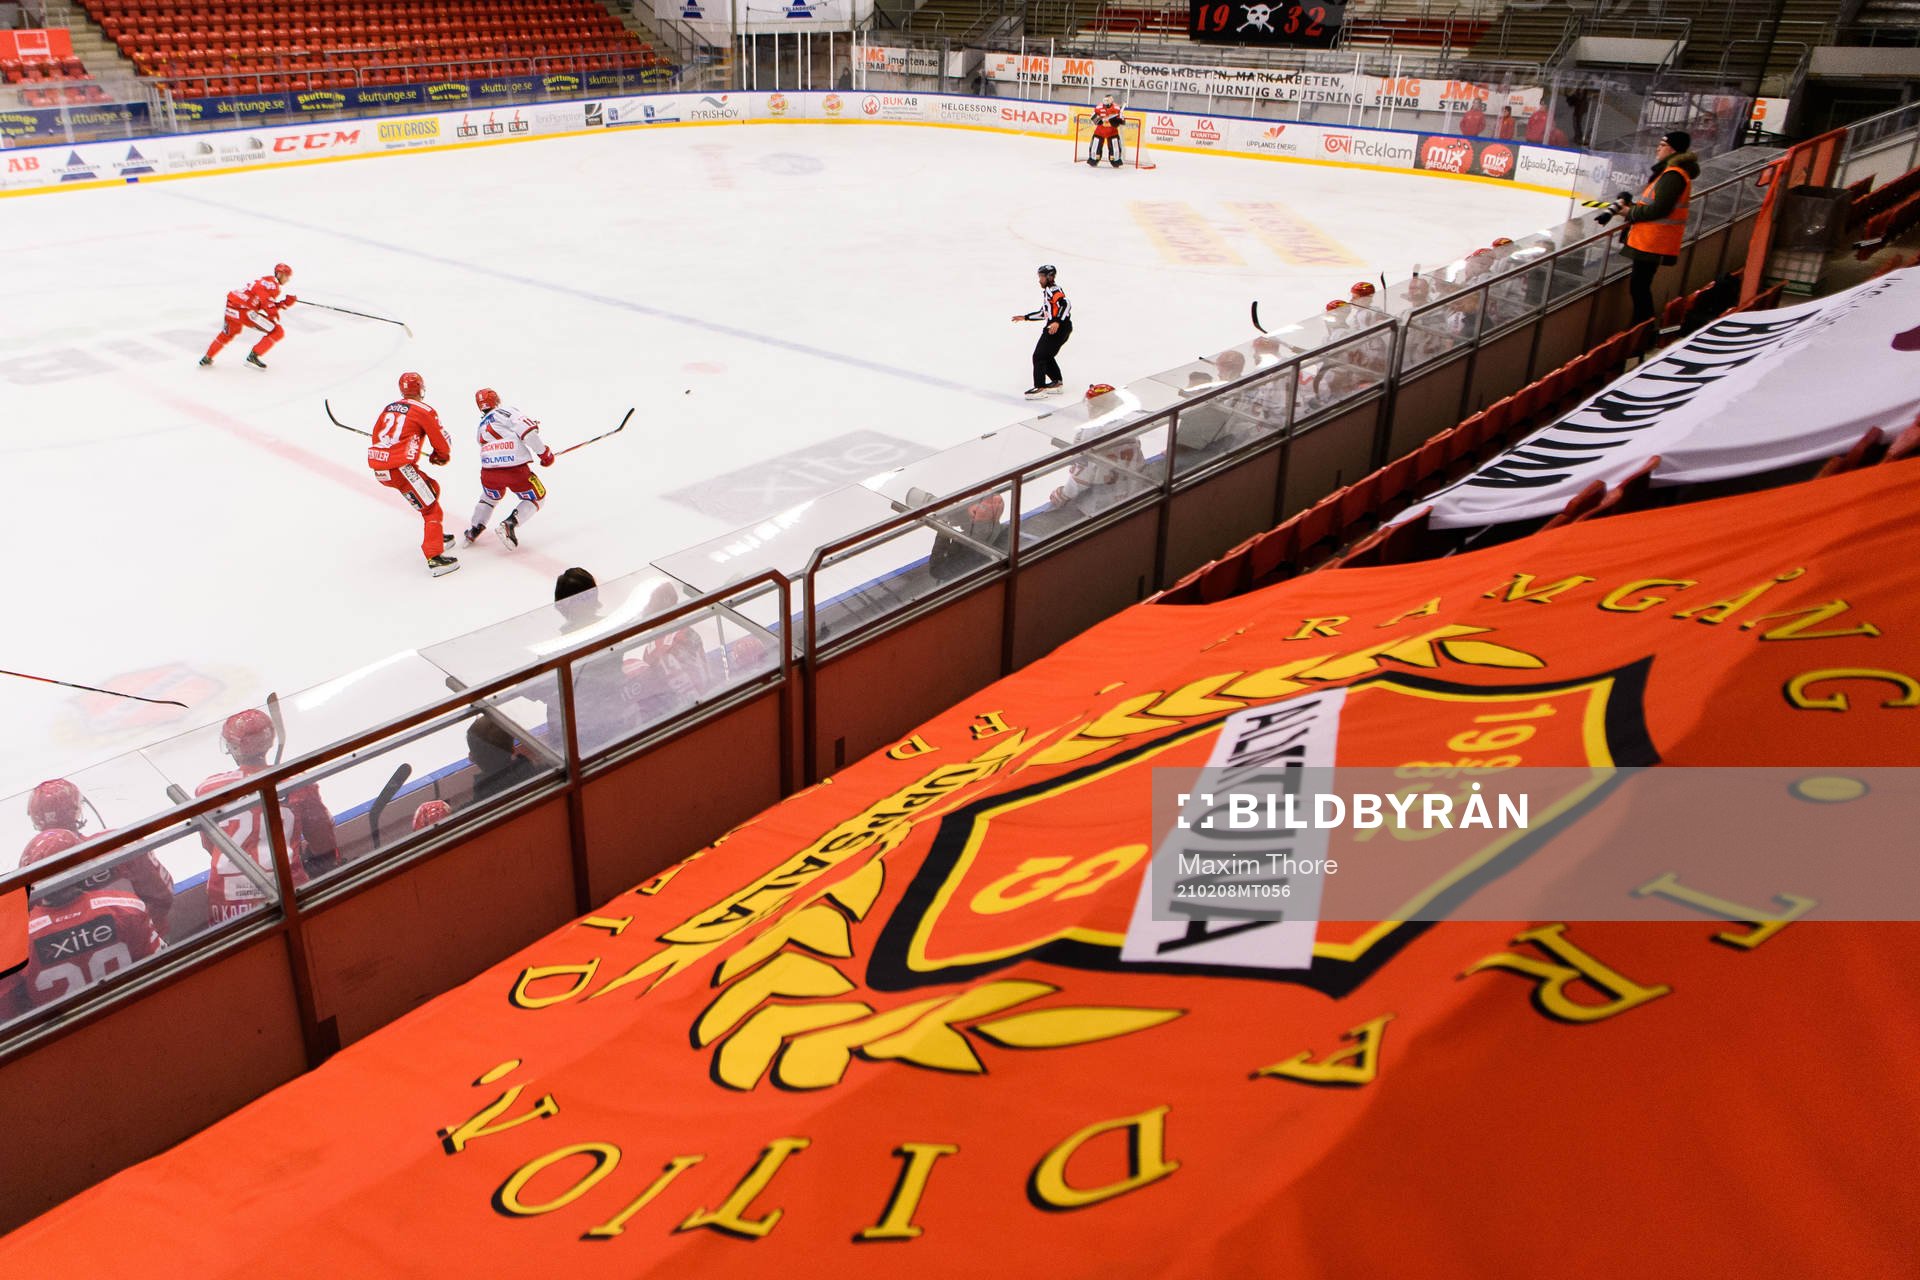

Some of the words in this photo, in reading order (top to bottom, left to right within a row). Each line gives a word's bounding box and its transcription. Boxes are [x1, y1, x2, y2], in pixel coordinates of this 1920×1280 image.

[1197, 4, 1231, 32] 19
[1284, 5, 1326, 37] 32
[481, 81, 532, 94] skuttuge.se
[1274, 88, 1284, 98] &
[358, 91, 417, 104] skuttunge.se
[1405, 97, 1419, 107] AB
[217, 99, 285, 113] skuttunge.se
[941, 103, 998, 114] HELGESSONS
[55, 112, 133, 127] suttunge.se
[691, 109, 739, 120] FYRISHOV
[1000, 108, 1067, 125] SHARP
[1157, 115, 1174, 127] ICA
[380, 124, 402, 138] CITY
[404, 121, 438, 137] GROSS
[1197, 119, 1215, 131] ICA
[273, 129, 361, 153] CCM
[1246, 140, 1275, 150] UPPLANDS
[1354, 139, 1413, 161] Reklam
[8, 157, 40, 173] AB
[379, 413, 406, 443] 21
[482, 455, 515, 464] HOLMEN
[697, 766, 979, 929] UPPSALA
[51, 925, 113, 959] xite
